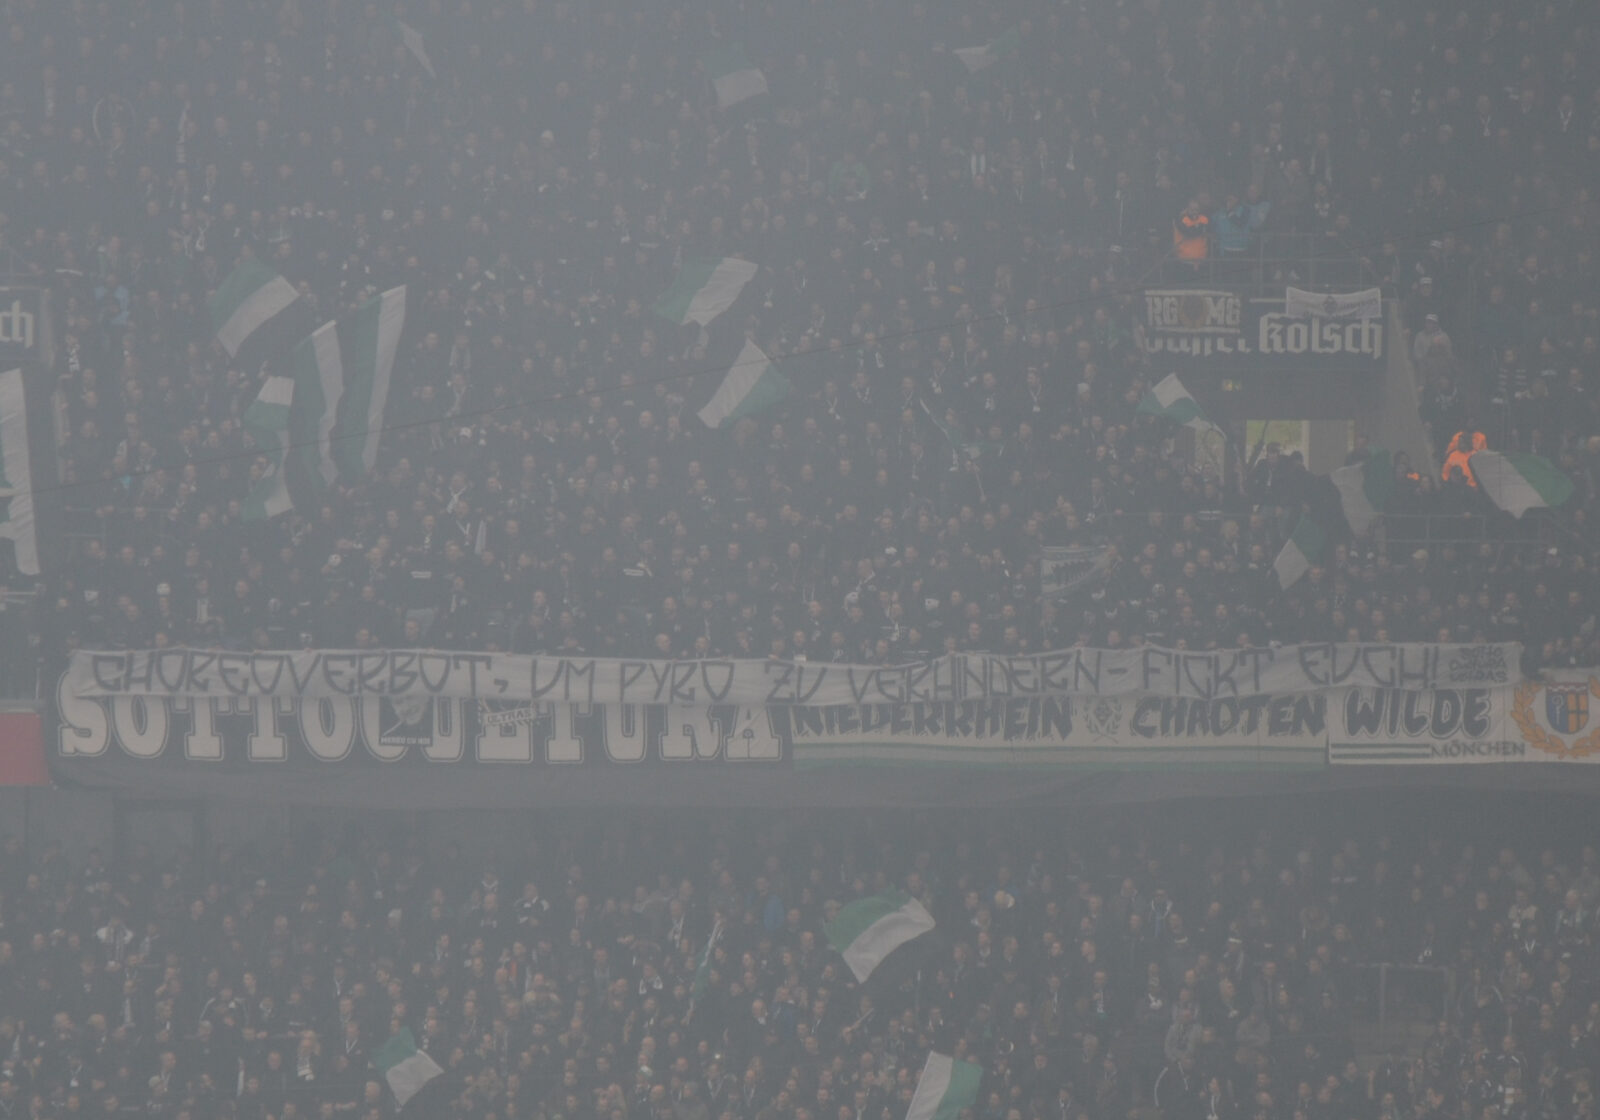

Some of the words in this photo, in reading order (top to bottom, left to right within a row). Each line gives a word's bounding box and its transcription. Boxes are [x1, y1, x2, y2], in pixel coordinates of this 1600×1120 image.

[531, 658, 594, 700] UM
[620, 661, 734, 701] PYRO
[764, 662, 826, 701] ZU
[1142, 647, 1273, 700] FICKT
[1299, 644, 1440, 690] EUCH!
[1132, 693, 1326, 738] CHAOTEN
[1343, 687, 1490, 739] WILDE
